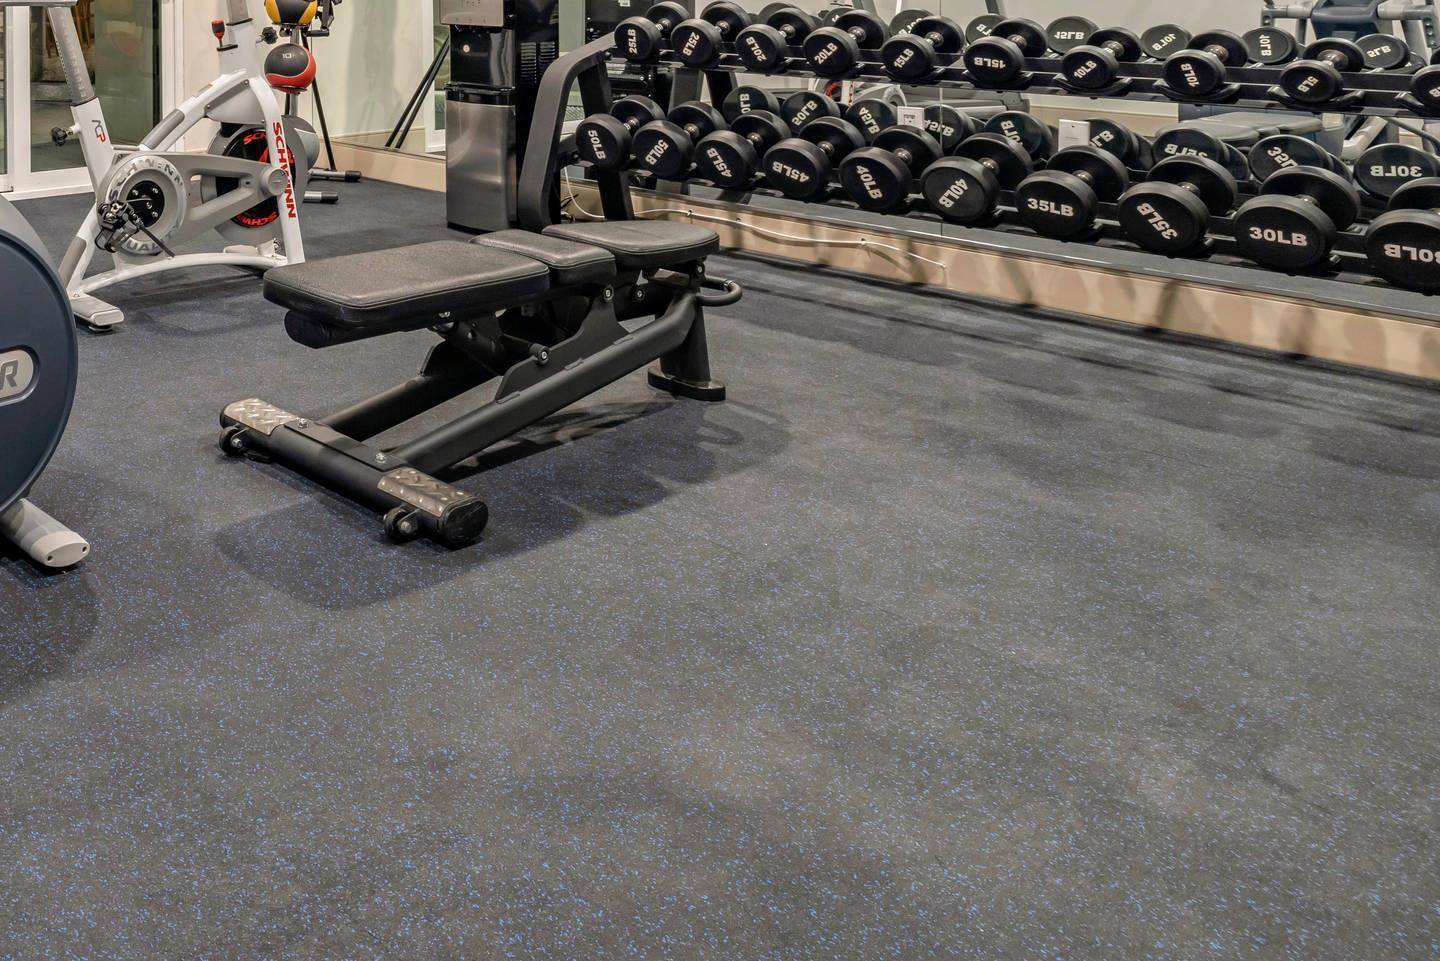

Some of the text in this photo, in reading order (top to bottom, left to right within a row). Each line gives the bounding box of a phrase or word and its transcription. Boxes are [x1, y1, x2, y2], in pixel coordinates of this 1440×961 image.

[627, 28, 637, 55] 25LB
[682, 31, 700, 56] 25LB
[745, 36, 768, 62] 20LB
[814, 42, 838, 65] 20LB
[893, 47, 915, 69] 15LB
[973, 56, 1006, 69] 15LB
[1073, 60, 1097, 79] 10LB
[1180, 62, 1200, 87] 10LB
[1297, 75, 1320, 93] 5LB
[587, 129, 607, 160] 50LB
[645, 139, 669, 166] 50LB
[272, 122, 297, 218] SCHWNN
[706, 147, 733, 178] 45LB
[772, 161, 810, 183] 45LB
[856, 165, 883, 200] 40LB
[938, 178, 969, 208] 40LB
[1027, 197, 1074, 217] 35LB
[1136, 202, 1178, 240] 35LB
[1249, 226, 1308, 247] 30LB
